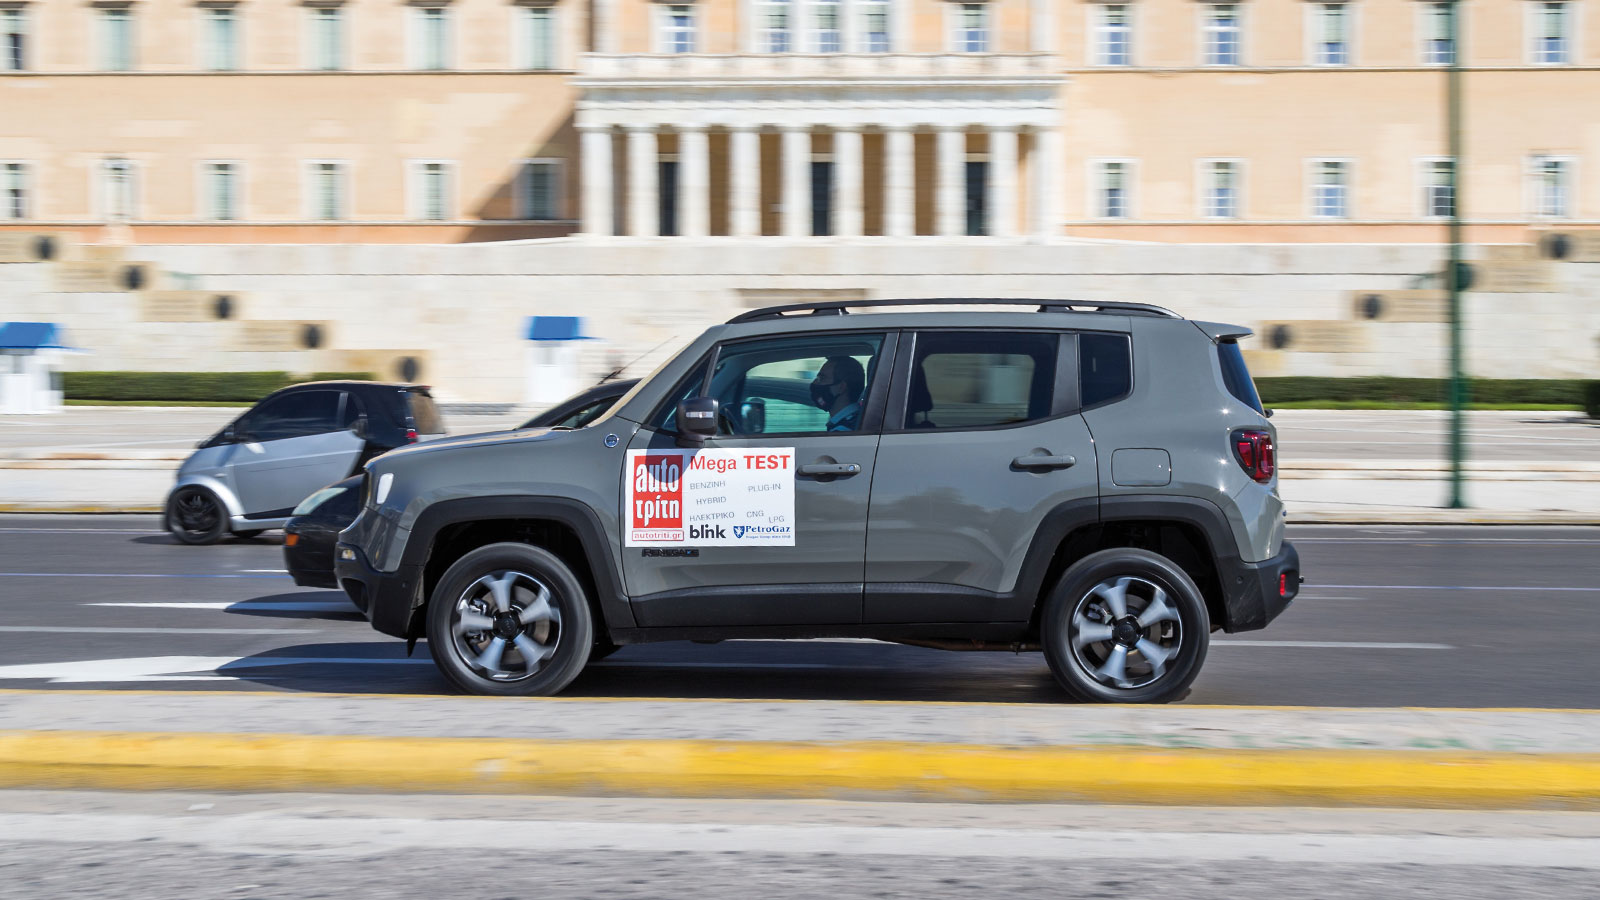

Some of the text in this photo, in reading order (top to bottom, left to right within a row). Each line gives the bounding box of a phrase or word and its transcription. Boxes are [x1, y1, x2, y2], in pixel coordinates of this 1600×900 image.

[690, 455, 790, 473] Mega TEST
[636, 457, 680, 493] auto
[748, 483, 781, 492] PLUG-IN
[696, 496, 727, 505] HYBRID
[636, 495, 680, 527] τρίτη
[746, 510, 765, 518] CNG
[768, 515, 785, 524] LPG
[690, 524, 726, 539] blink
[745, 525, 791, 533] PetroGaz
[634, 532, 682, 541] autotriti.gr
